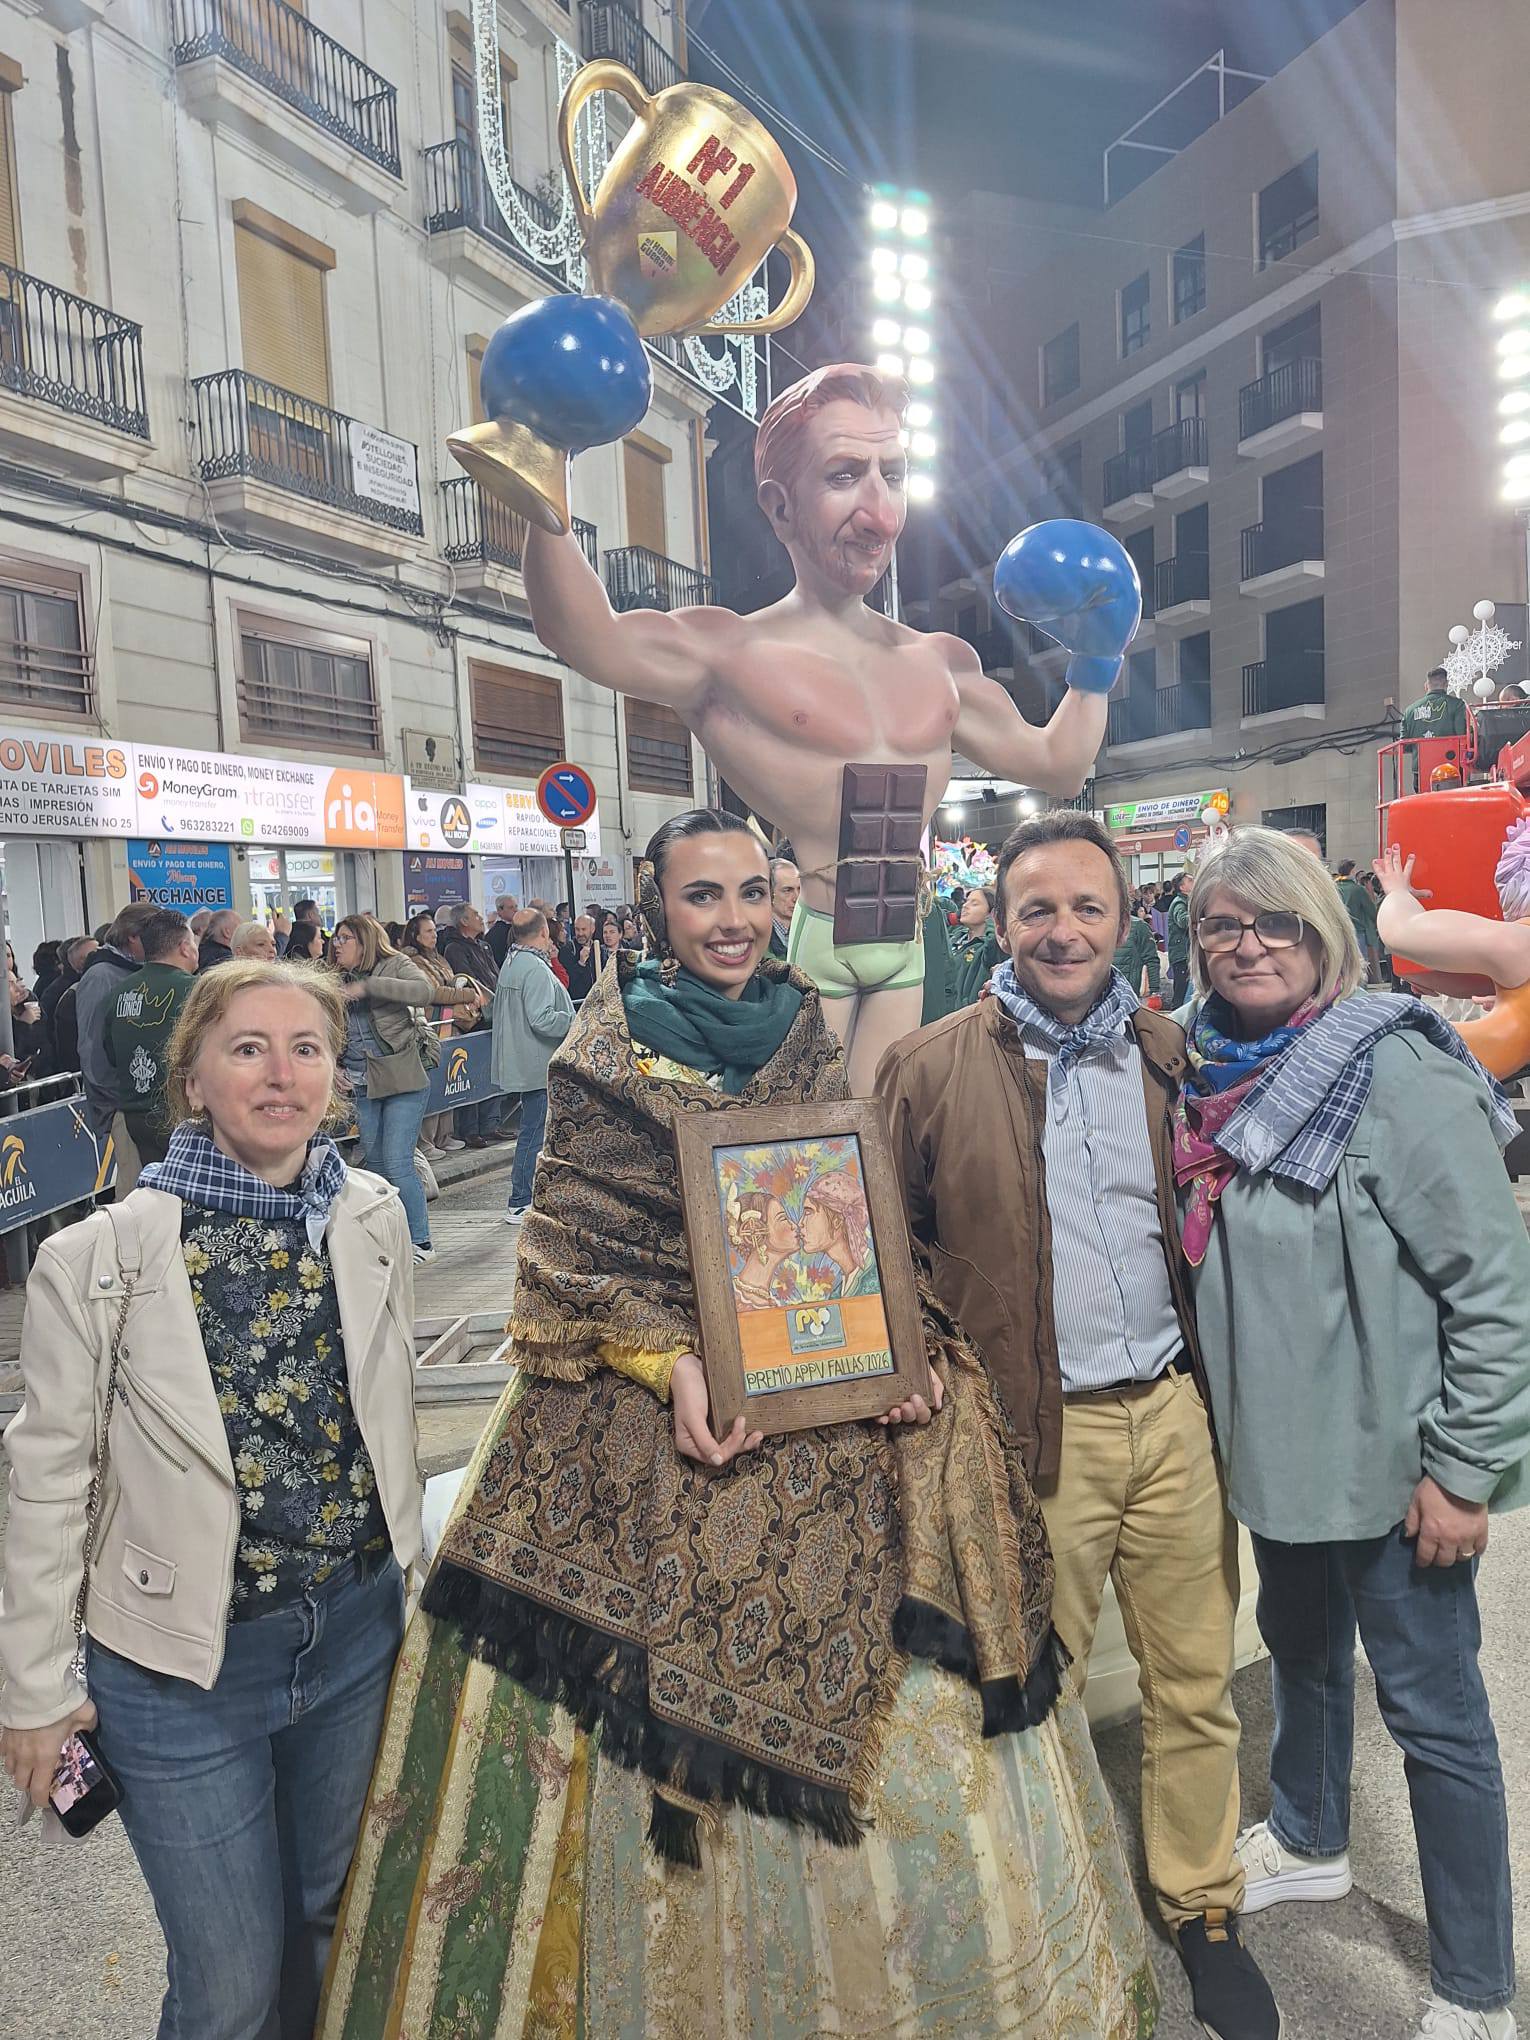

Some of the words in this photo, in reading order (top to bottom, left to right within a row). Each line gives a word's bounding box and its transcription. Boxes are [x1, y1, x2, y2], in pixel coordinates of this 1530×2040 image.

[168, 757, 174, 770] Y
[176, 759, 199, 773] PAGO
[201, 761, 213, 775] DE
[214, 763, 247, 780] DINERO,
[247, 766, 274, 781] MONEY
[276, 769, 315, 785] EXCHANGE
[0, 780, 18, 791] TA
[22, 781, 38, 792] DE
[41, 782, 99, 797] TARJETAS
[102, 787, 121, 798] SIM
[162, 780, 237, 799] MoneyGram
[0, 797, 20, 808] AS
[30, 798, 93, 813] IMPRESIÓN
[328, 784, 376, 832] ria
[1137, 804, 1159, 813] ENVIO
[1160, 802, 1171, 810] DE
[1172, 798, 1200, 808] DINERO
[32, 814, 98, 828] JERUSALÉN
[120, 818, 132, 829] 25
[180, 819, 235, 833] 963283221
[261, 824, 309, 837] 624269009
[508, 826, 557, 838] REPARACIONES
[520, 842, 529, 852] DE
[186, 861, 196, 869] DE
[136, 887, 227, 905] EXCHANGE
[794, 1361, 824, 1384] APPV
[828, 1354, 865, 1378] FALLAS
[864, 1351, 890, 1372] 2026
